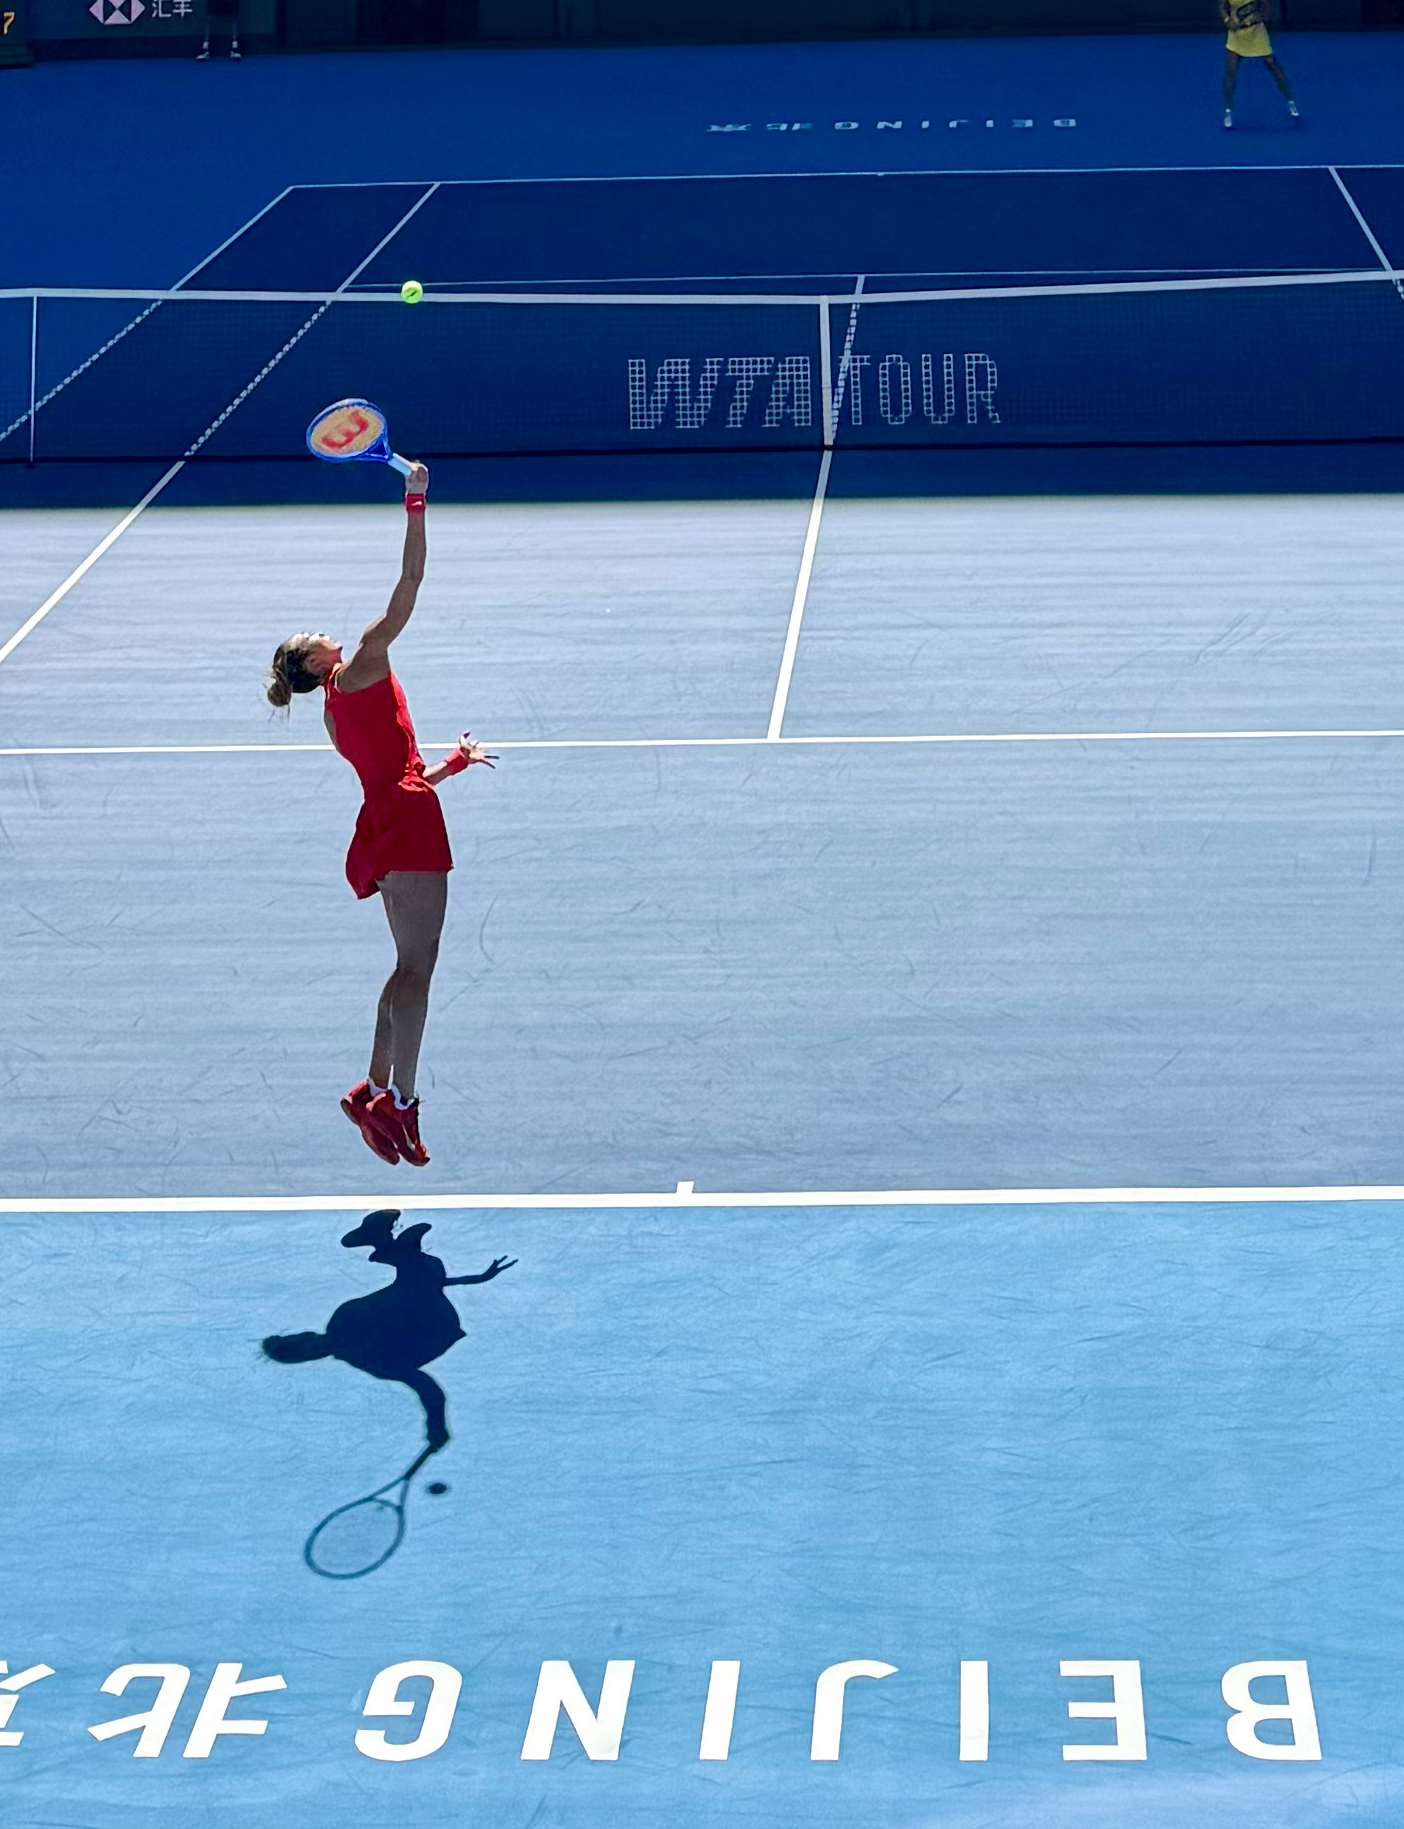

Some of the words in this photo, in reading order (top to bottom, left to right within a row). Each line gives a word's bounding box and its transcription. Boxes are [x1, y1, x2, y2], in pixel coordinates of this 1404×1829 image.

[628, 356, 812, 430] WTA
[838, 353, 1000, 426] TOUR
[353, 1659, 1323, 1762] BEIJING
